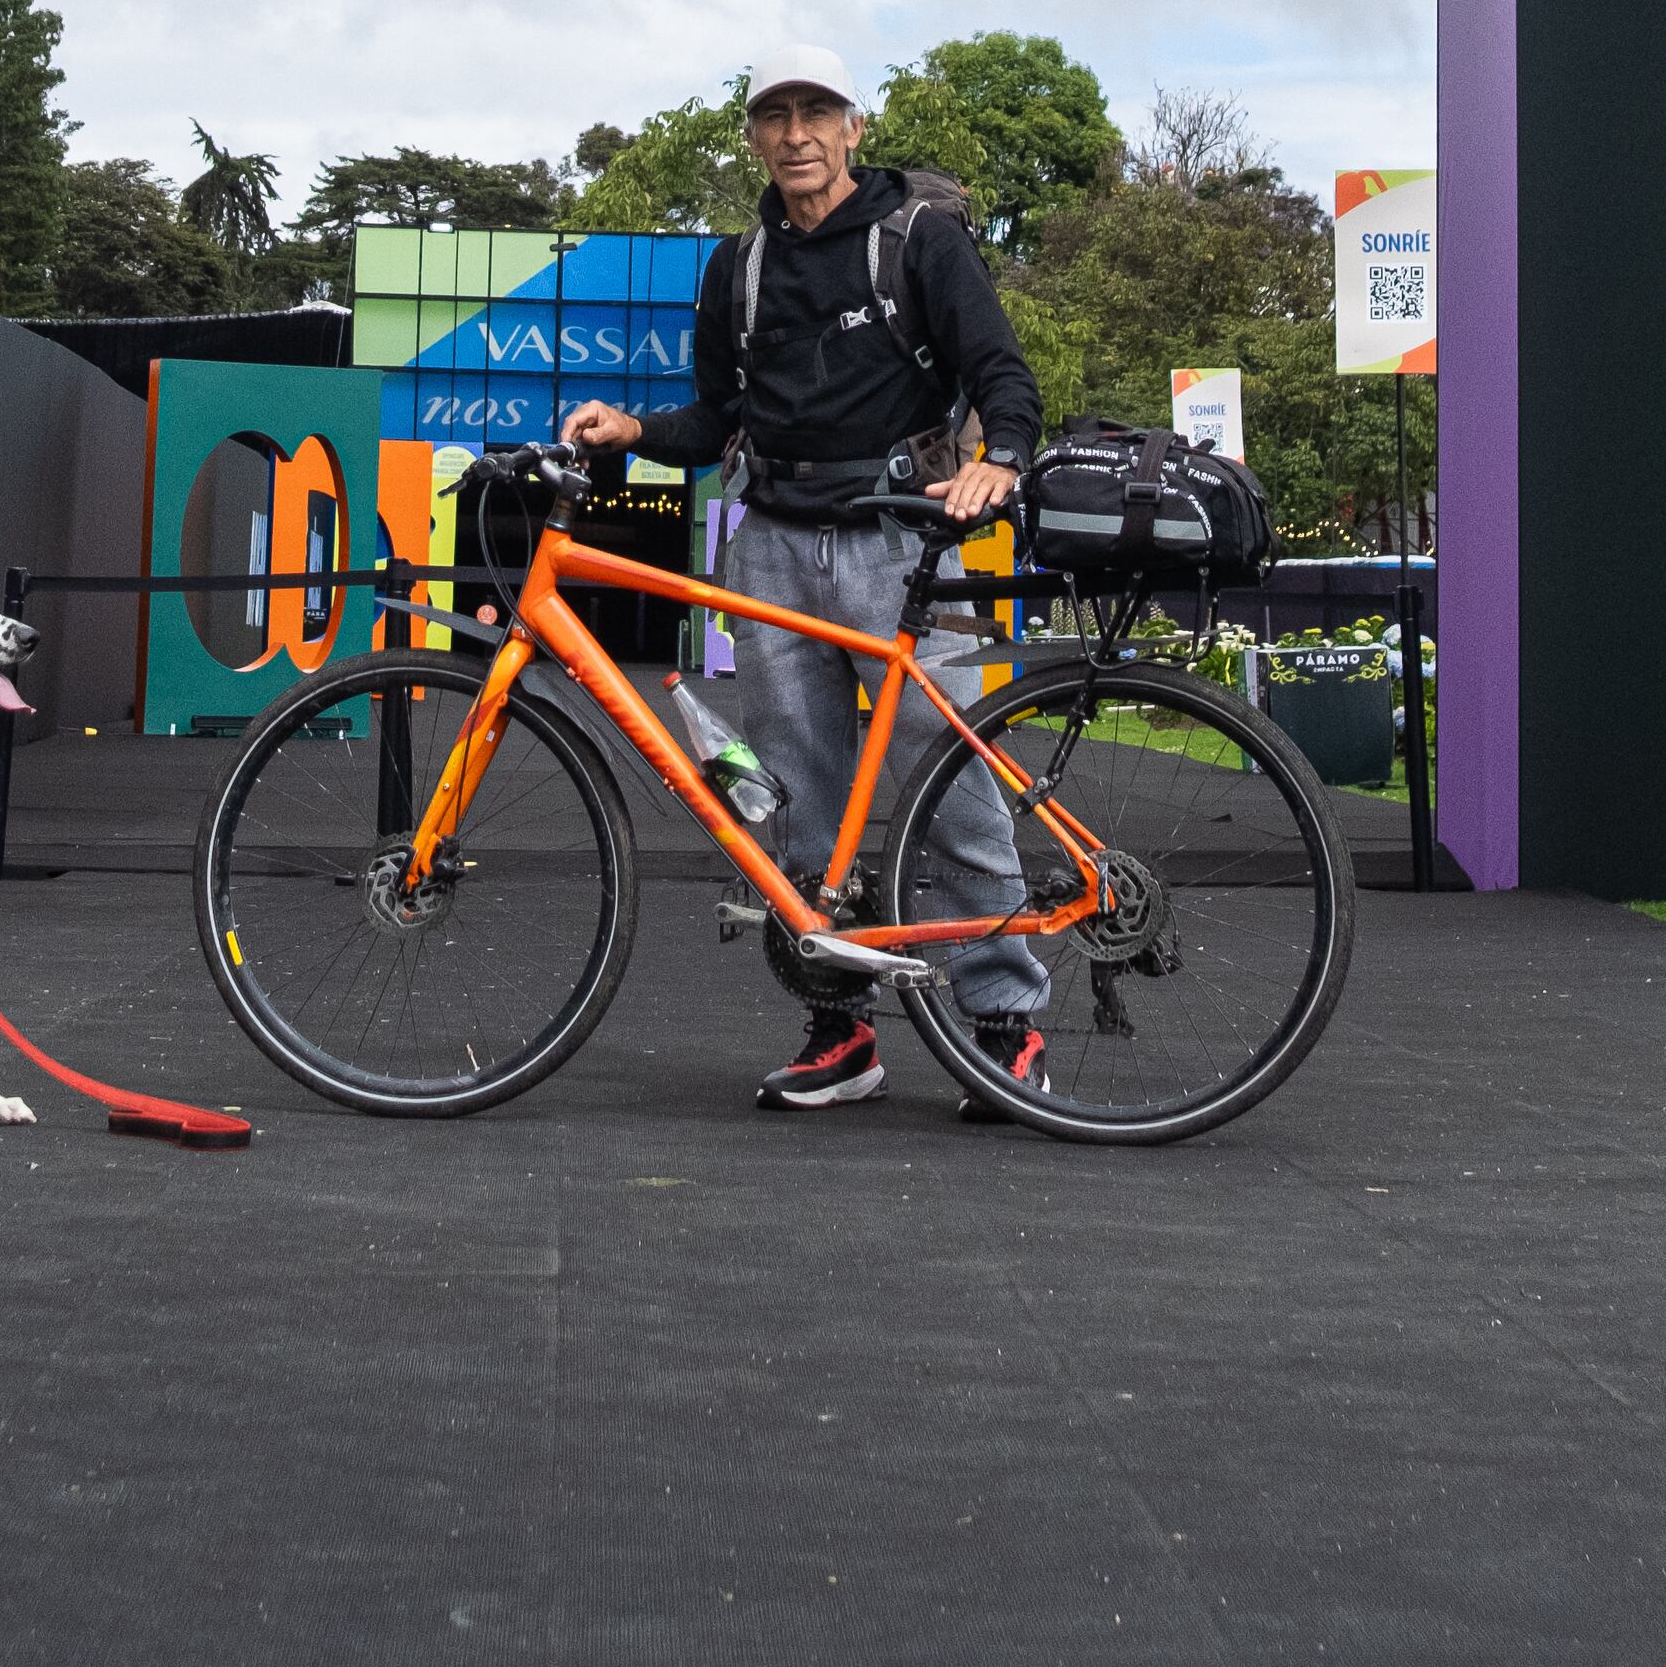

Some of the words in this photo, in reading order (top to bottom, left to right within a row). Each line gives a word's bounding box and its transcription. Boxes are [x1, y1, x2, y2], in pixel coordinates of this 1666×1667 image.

[1361, 229, 1431, 254] SONRÍE
[421, 395, 530, 428] nos
[1188, 401, 1227, 417] SONRÍE
[1070, 447, 1120, 461] FASHION
[1187, 467, 1223, 486] FASHI
[1296, 652, 1361, 666] PÁRAMO
